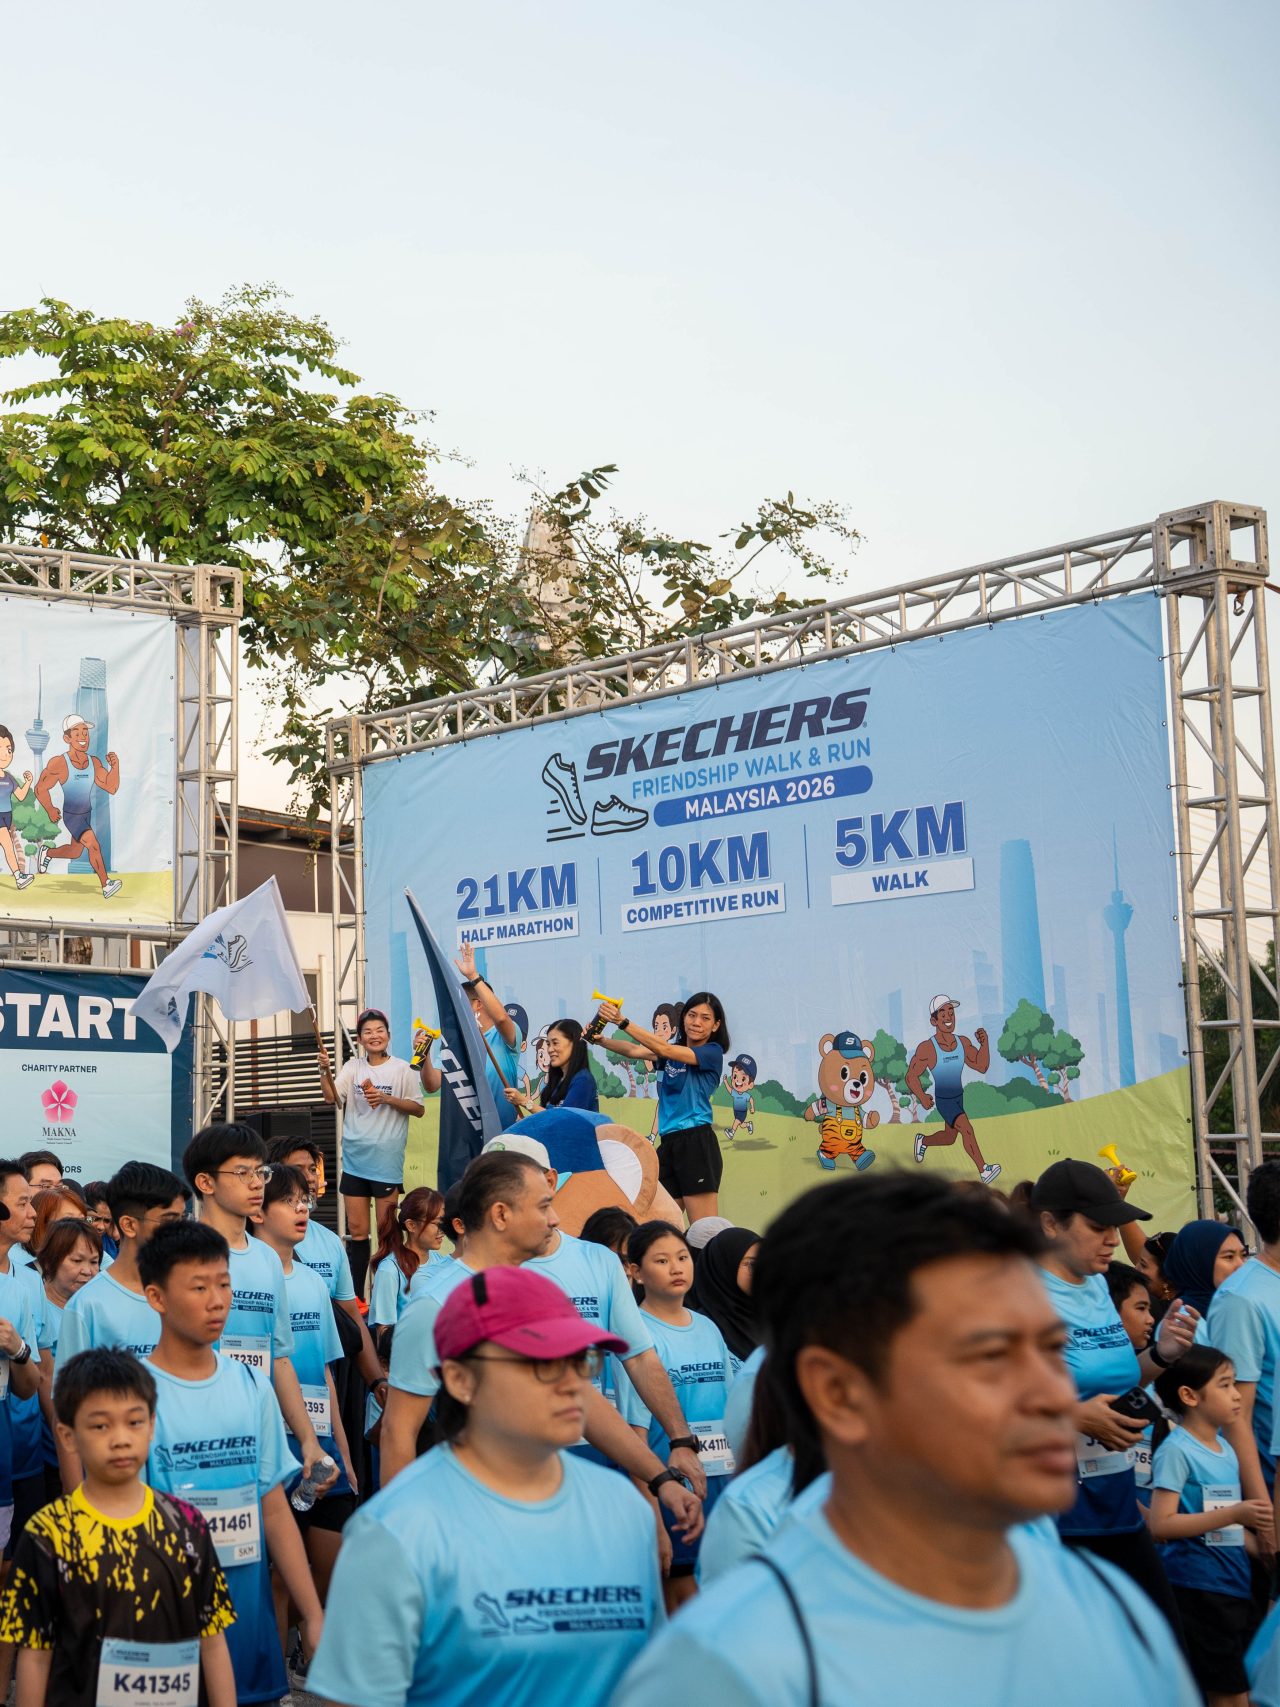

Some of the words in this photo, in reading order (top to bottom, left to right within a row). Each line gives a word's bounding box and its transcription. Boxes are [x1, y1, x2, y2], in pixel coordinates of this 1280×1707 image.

[583, 687, 871, 782] SKECHERS
[632, 763, 740, 799] FRIENDSHIP
[745, 751, 802, 779] WALK
[808, 747, 821, 766] &
[828, 737, 871, 763] RUN
[686, 788, 780, 819] MALAYSIA
[786, 776, 835, 803] 2026
[835, 801, 967, 867] 5KM
[631, 831, 771, 897] 10KM
[456, 862, 577, 920] 21KM
[872, 871, 929, 892] WALK
[626, 896, 740, 924] COMPETITIVE
[742, 889, 780, 909] RUN
[461, 926, 495, 943] HALF
[497, 918, 574, 938] MARATHON
[22, 1064, 58, 1072] CHARITY
[59, 1065, 98, 1073] PARTNER
[42, 1127, 77, 1137] MAKNA
[232, 1290, 275, 1302] KECHERS
[230, 1354, 263, 1366] 32391
[209, 1512, 252, 1533] 41461
[504, 1585, 642, 1608] SKECHERS
[114, 1672, 191, 1694] K41345
